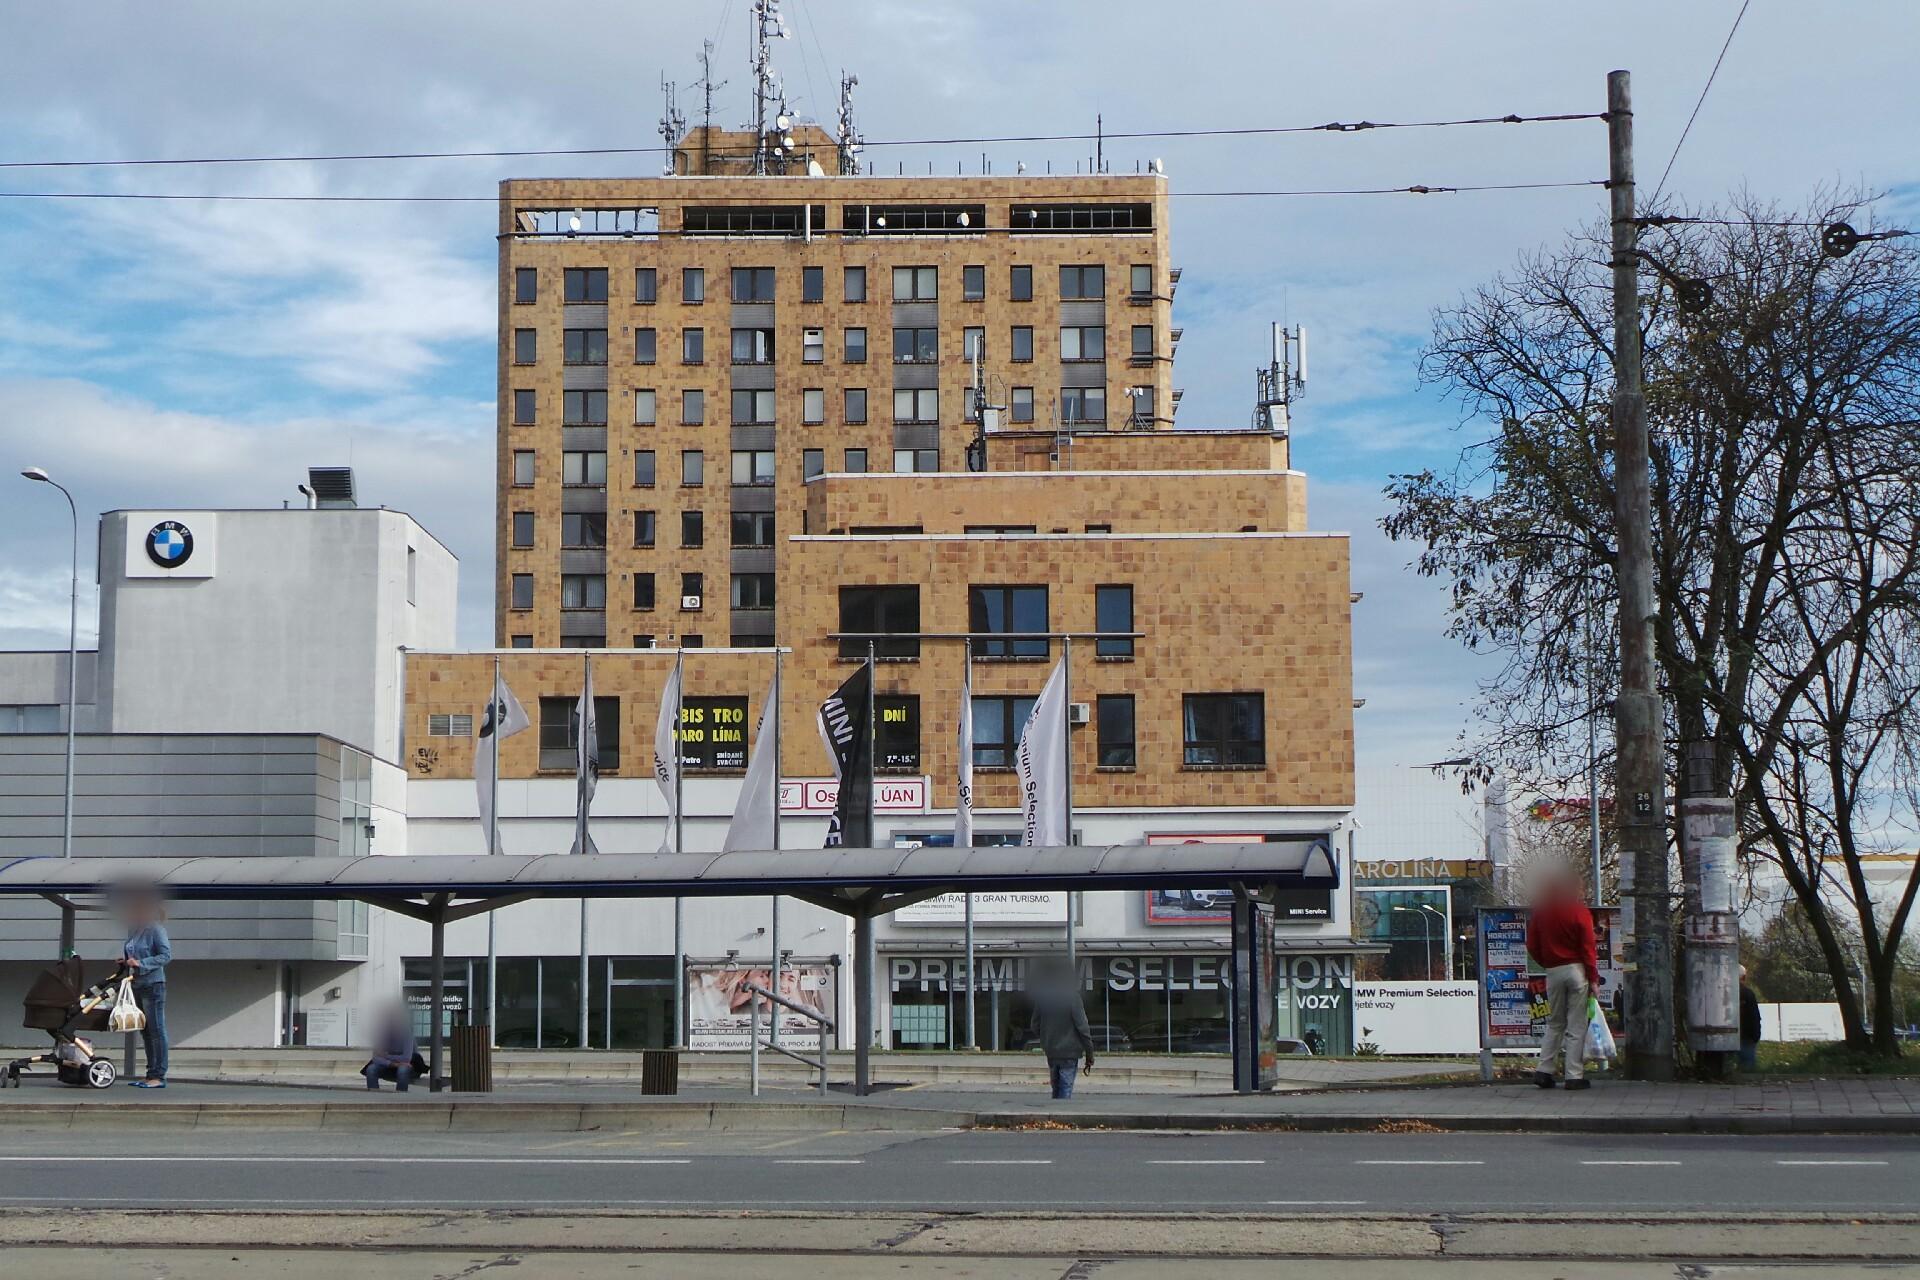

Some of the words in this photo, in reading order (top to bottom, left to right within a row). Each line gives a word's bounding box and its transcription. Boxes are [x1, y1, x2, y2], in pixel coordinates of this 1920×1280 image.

[151, 522, 189, 537] BMW
[681, 708, 704, 723] BIS
[712, 708, 743, 723] TRO
[824, 698, 853, 744] MINI
[883, 706, 906, 721] DNÍ
[712, 726, 742, 742] LÍNA
[881, 786, 914, 802] ÚAN
[1638, 803, 1650, 811] 12
[974, 895, 980, 903] 3
[982, 894, 1007, 903] GRAN
[1355, 988, 1376, 997] MW
[1379, 988, 1424, 997] Premium
[1426, 987, 1477, 997] Selection.
[1296, 995, 1340, 1009] VOZY
[1375, 1002, 1395, 1010] vozy
